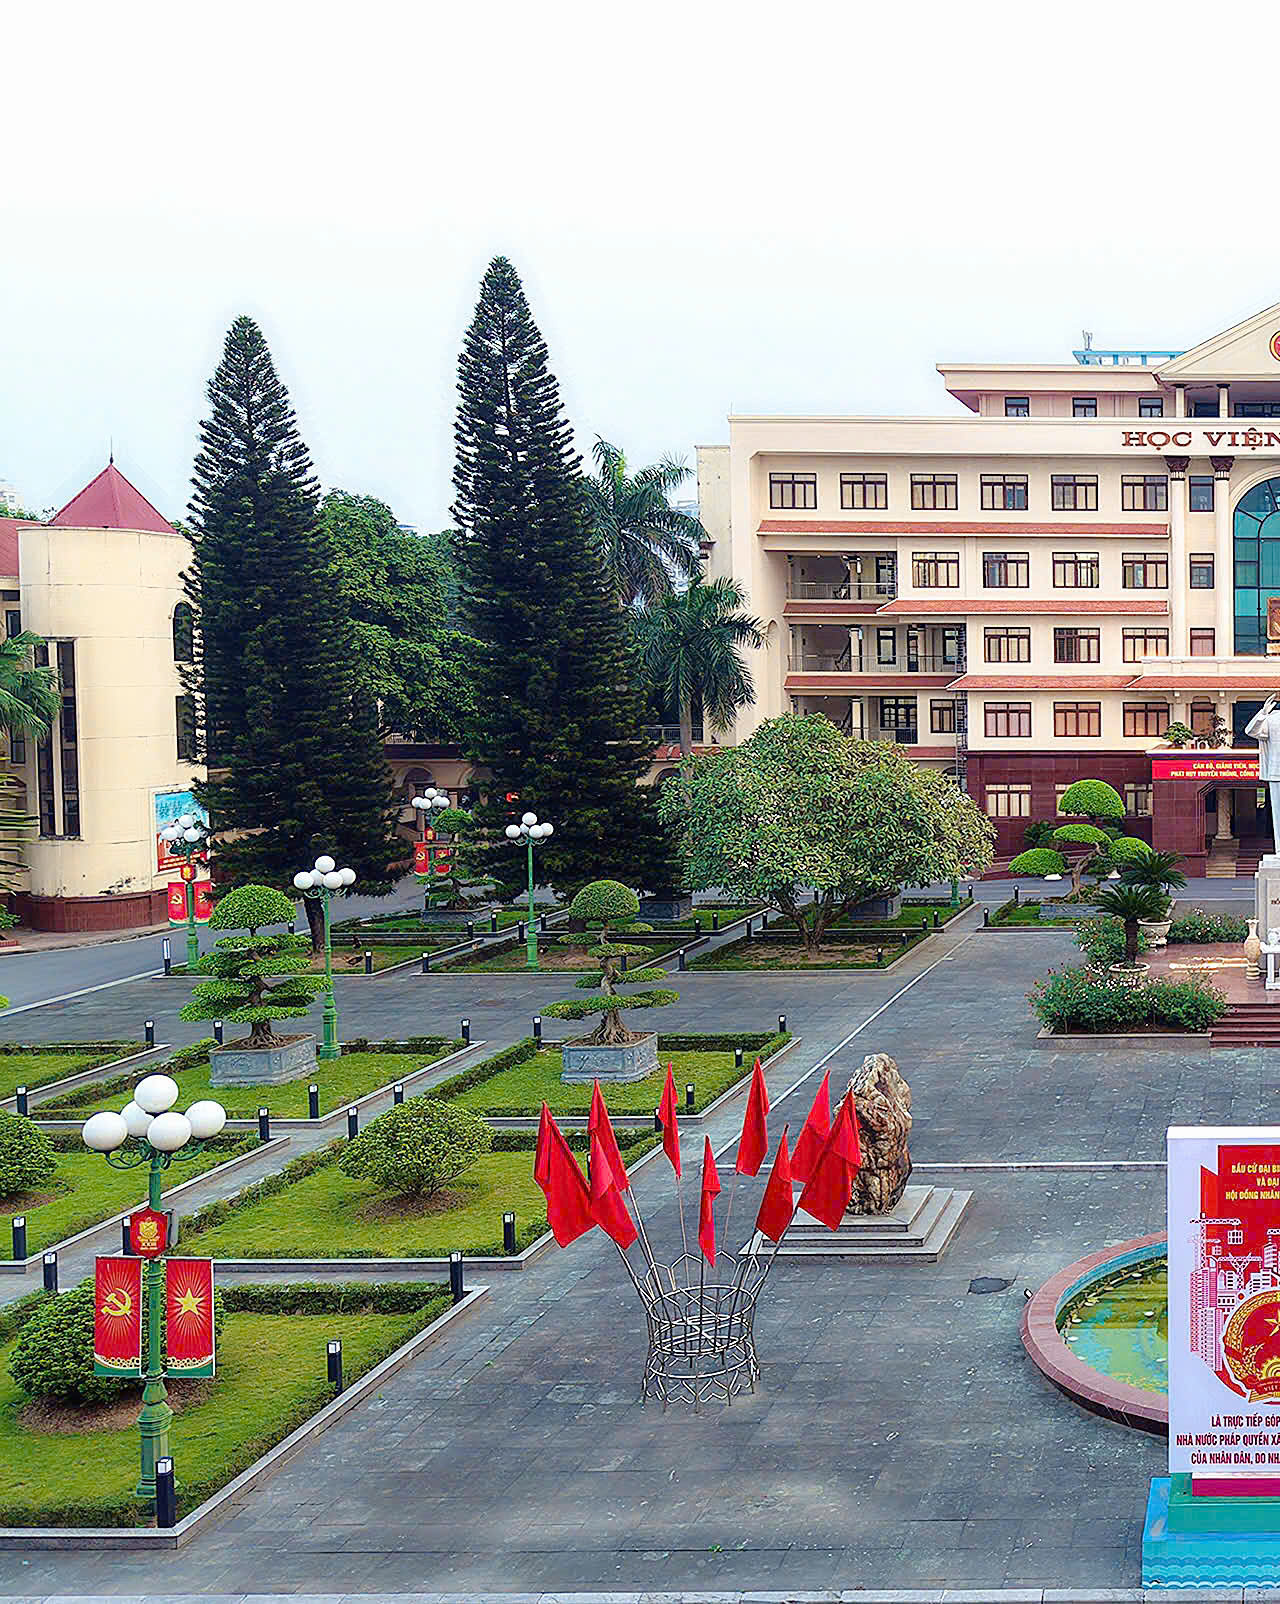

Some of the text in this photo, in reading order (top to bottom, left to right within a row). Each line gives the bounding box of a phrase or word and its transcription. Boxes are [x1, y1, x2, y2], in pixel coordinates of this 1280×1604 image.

[1121, 431, 1192, 451] HỌC
[1231, 1162, 1246, 1173] BẦU
[1247, 1162, 1257, 1173] CỬ
[1258, 1164, 1271, 1175] ĐẠI
[1256, 1177, 1266, 1186] VÀ
[1267, 1177, 1280, 1188] ĐẠI
[1225, 1189, 1238, 1201] HỘI
[1239, 1189, 1258, 1199] ĐỒNG
[1260, 1189, 1280, 1199] NHÂN
[1211, 1414, 1221, 1427] LÀ
[1223, 1415, 1243, 1429] TRỰC
[1246, 1412, 1263, 1427] TIẾP
[1265, 1414, 1280, 1427] GÓP
[1176, 1432, 1193, 1445] NHÀ
[1195, 1432, 1217, 1445] NƯỚC
[1219, 1432, 1241, 1445] PHÁP
[1243, 1431, 1269, 1446] QUYỀN
[1191, 1450, 1207, 1464] CỦA
[1209, 1451, 1232, 1464] NHÂN
[1233, 1451, 1253, 1464] DÂN,
[1255, 1452, 1266, 1464] DO
